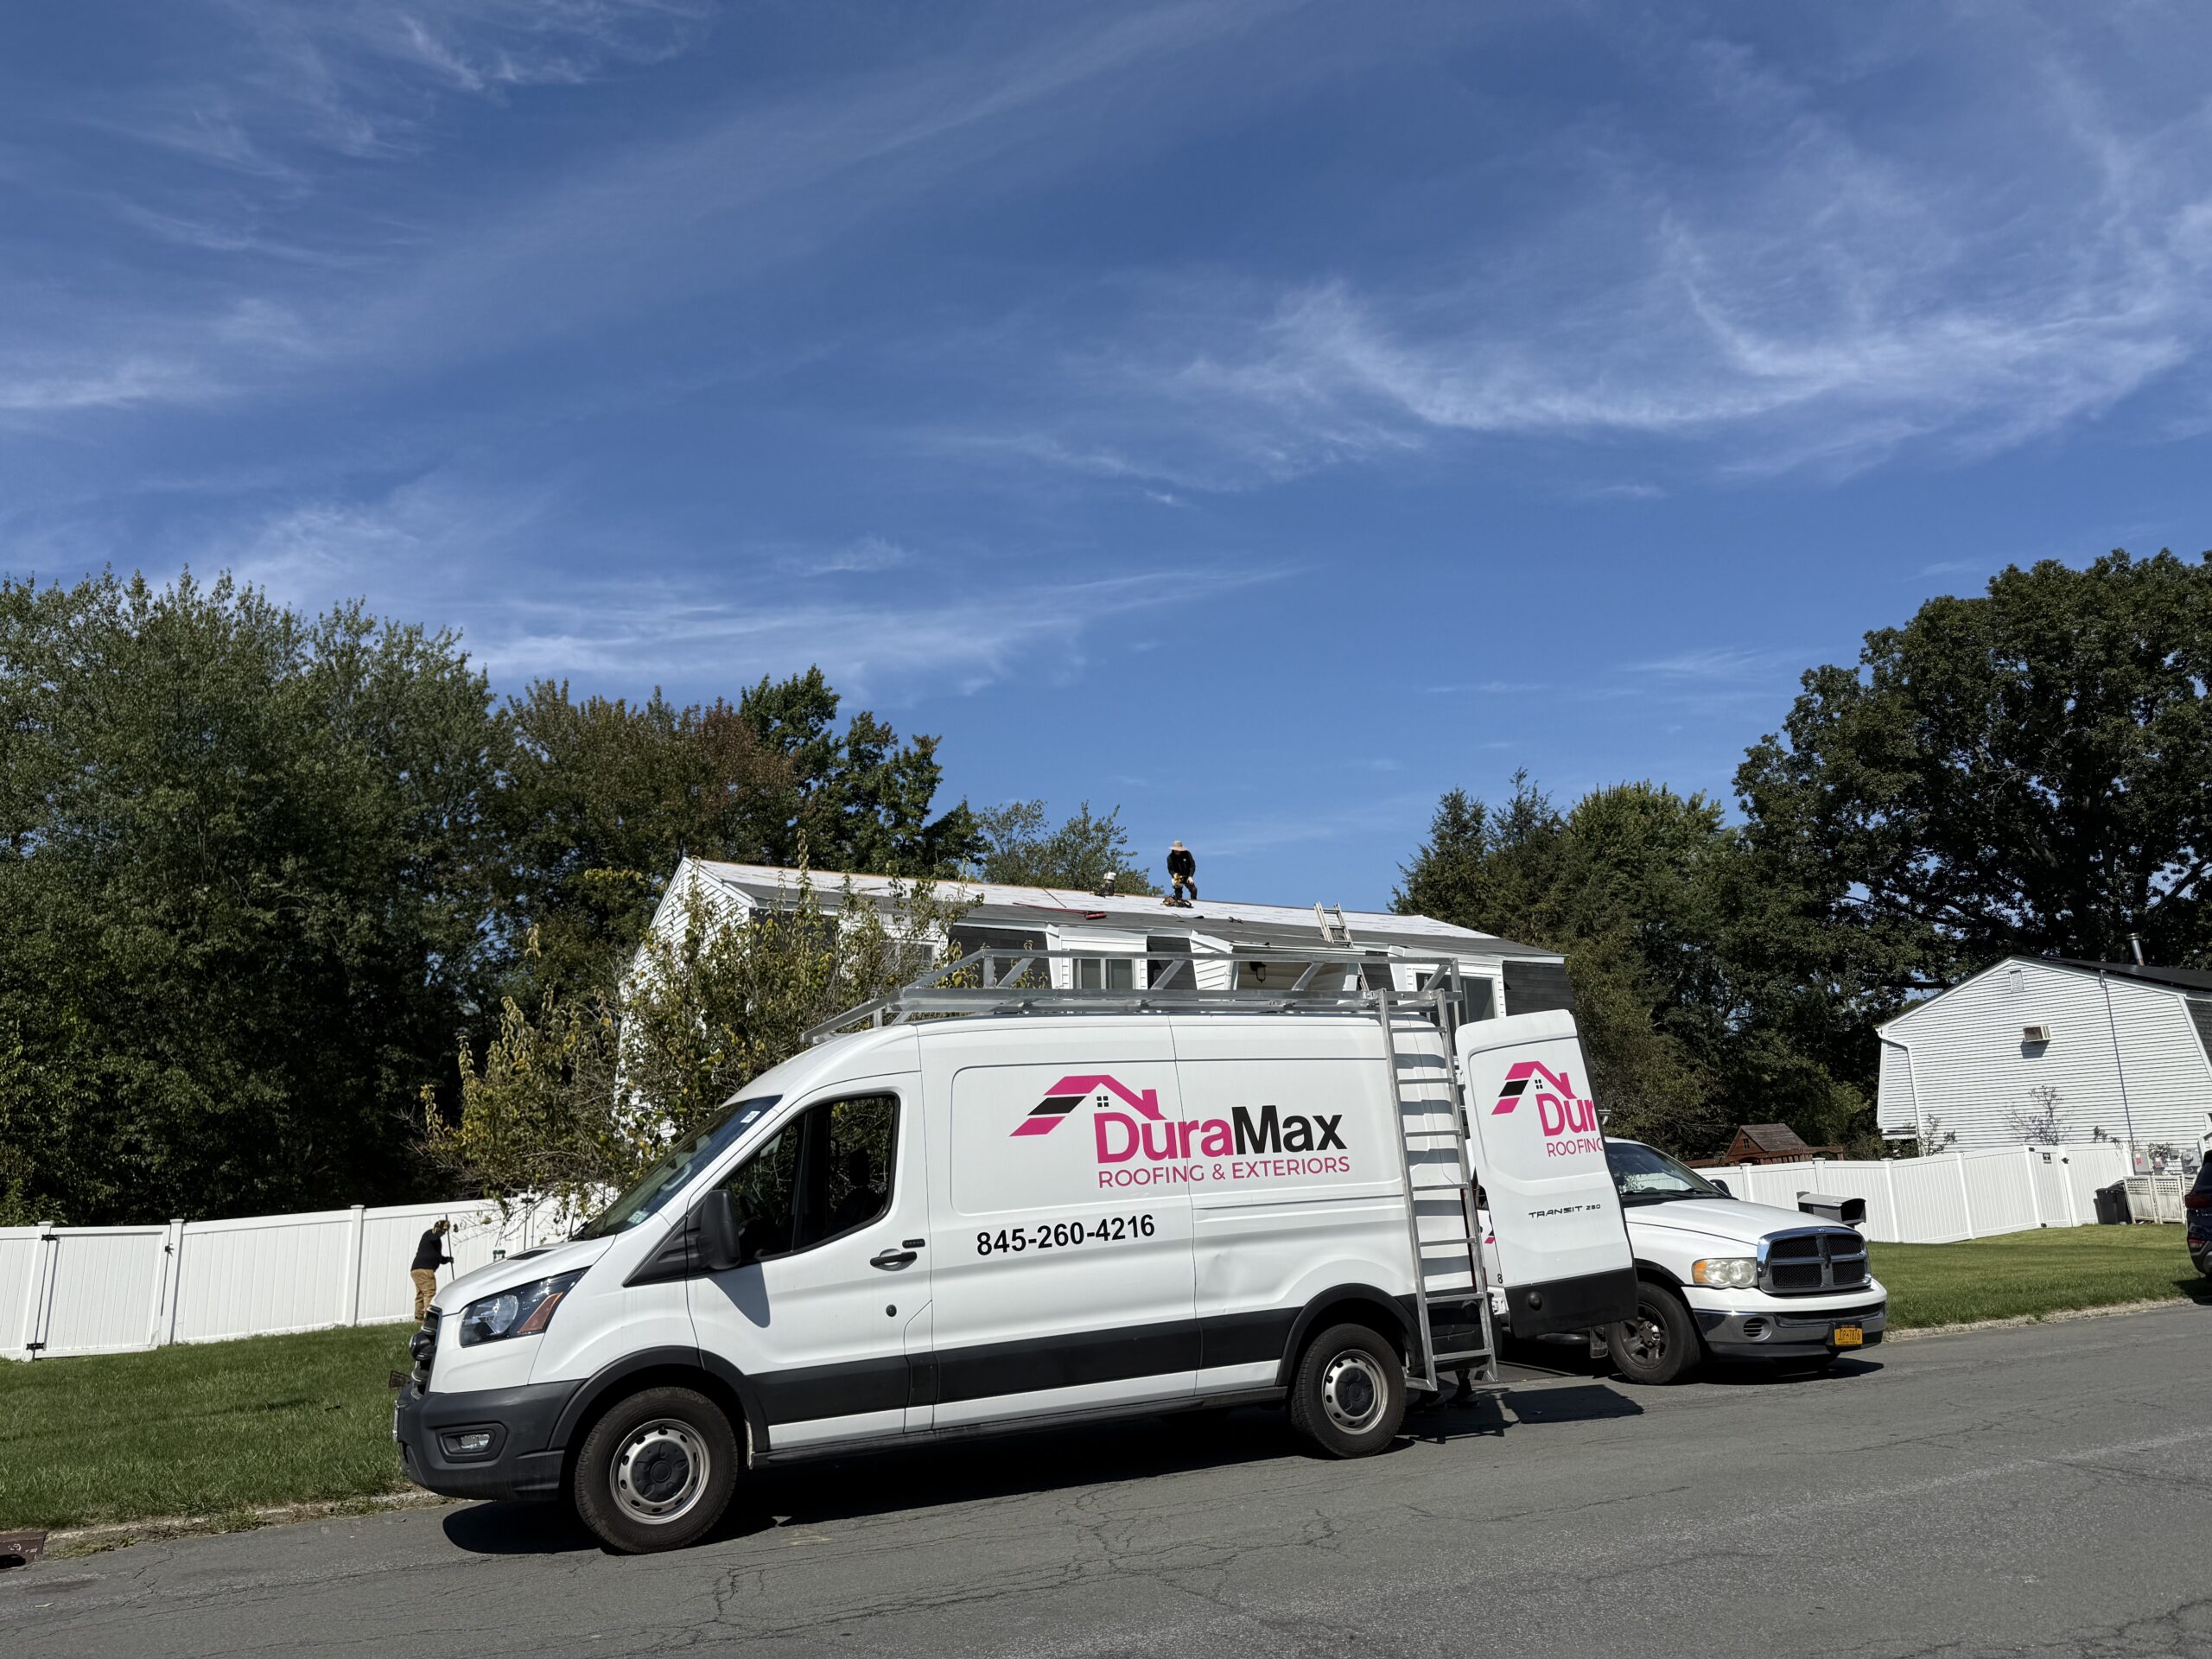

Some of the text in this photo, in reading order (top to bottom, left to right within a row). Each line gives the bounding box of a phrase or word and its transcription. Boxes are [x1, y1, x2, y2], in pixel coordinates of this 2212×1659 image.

[1093, 1105, 1348, 1164] DuraMax
[1098, 1155, 1351, 1189] ROOFING & EXTERIORS
[1528, 1205, 1583, 1218] TRANSIT
[976, 1214, 1155, 1255] 845-260-4216
